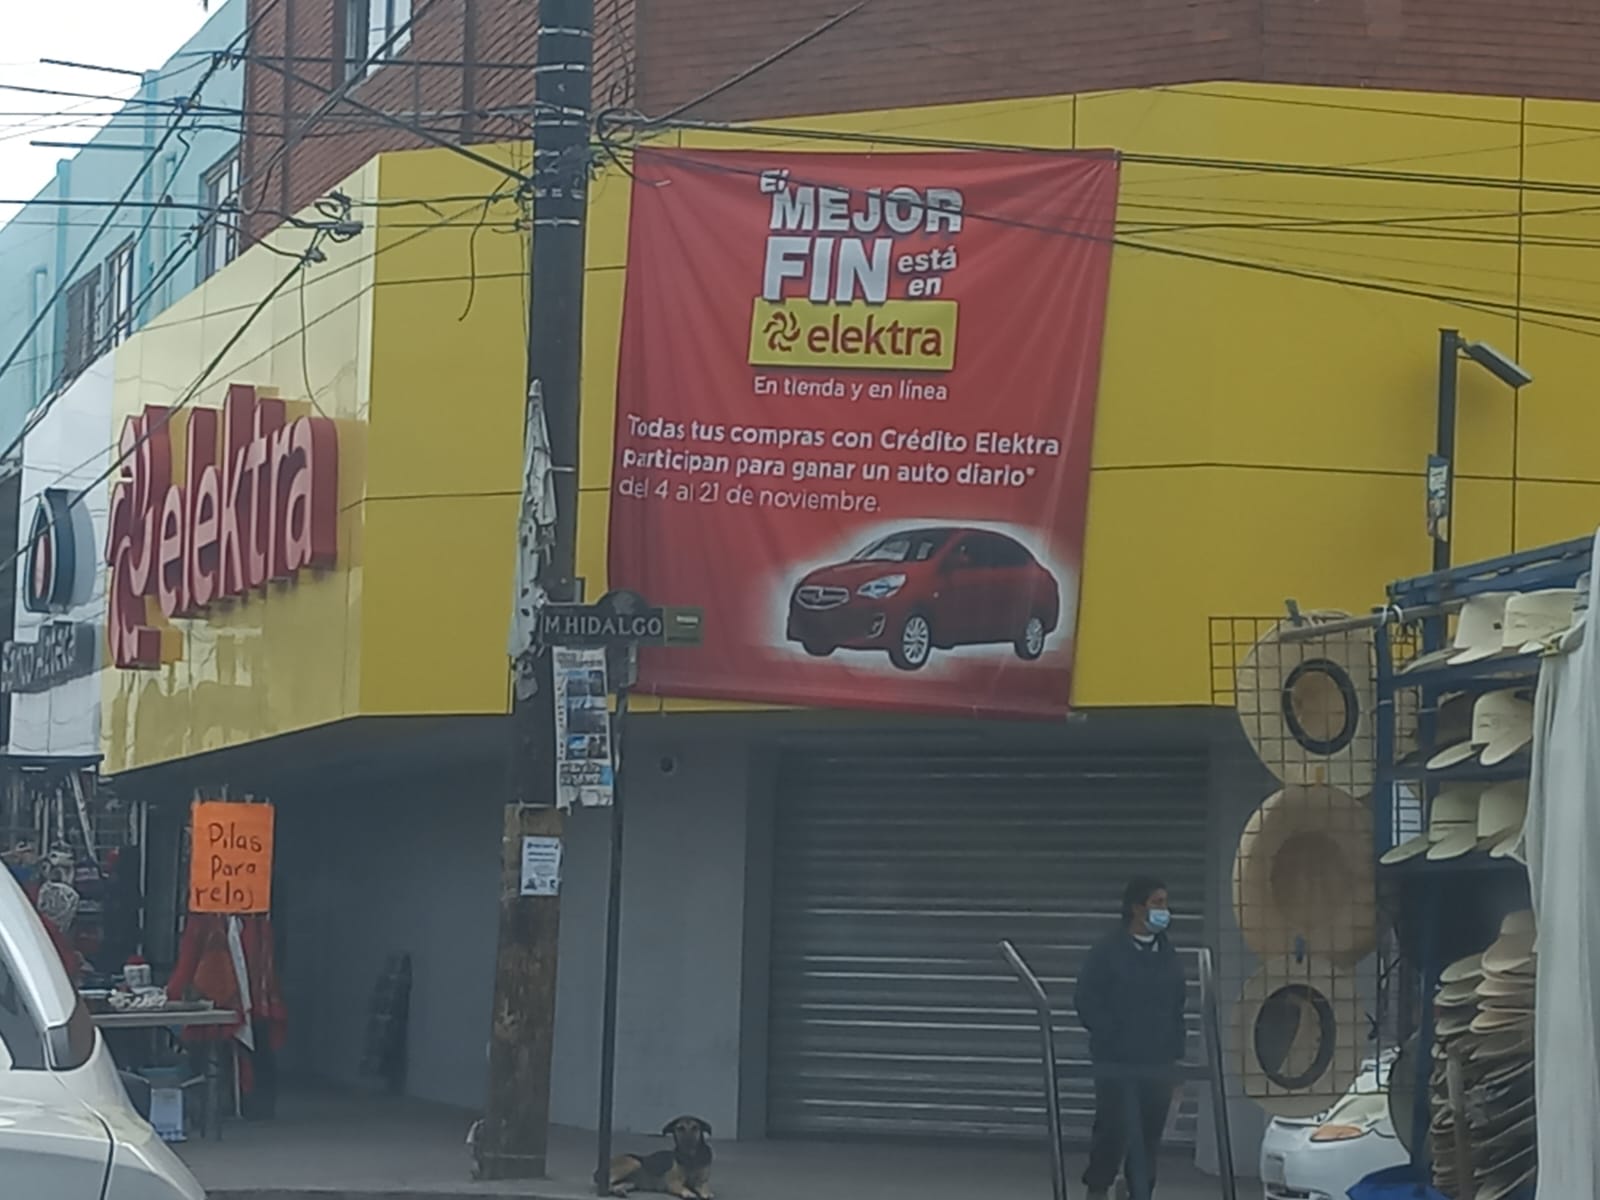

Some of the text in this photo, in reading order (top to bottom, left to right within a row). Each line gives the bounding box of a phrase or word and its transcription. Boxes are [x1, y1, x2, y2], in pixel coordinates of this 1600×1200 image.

[769, 186, 964, 234] MEJOR
[762, 236, 893, 303] FIN
[897, 245, 958, 273] está
[908, 277, 941, 297] en
[807, 313, 943, 357] elektra
[754, 376, 948, 401] En tienda y en línea
[627, 413, 1060, 456] Todas tus compras con Crédito Elektra
[622, 448, 729, 474] participan
[736, 457, 785, 477] para
[792, 460, 855, 481] ganar
[862, 463, 890, 481] un
[897, 464, 949, 484] auto
[158, 383, 337, 618] elektra
[619, 475, 881, 514] del 4 al 21 de noviembre.
[565, 616, 663, 636] HIDALGO
[208, 821, 263, 853] Pilas
[194, 879, 255, 911] reloj
